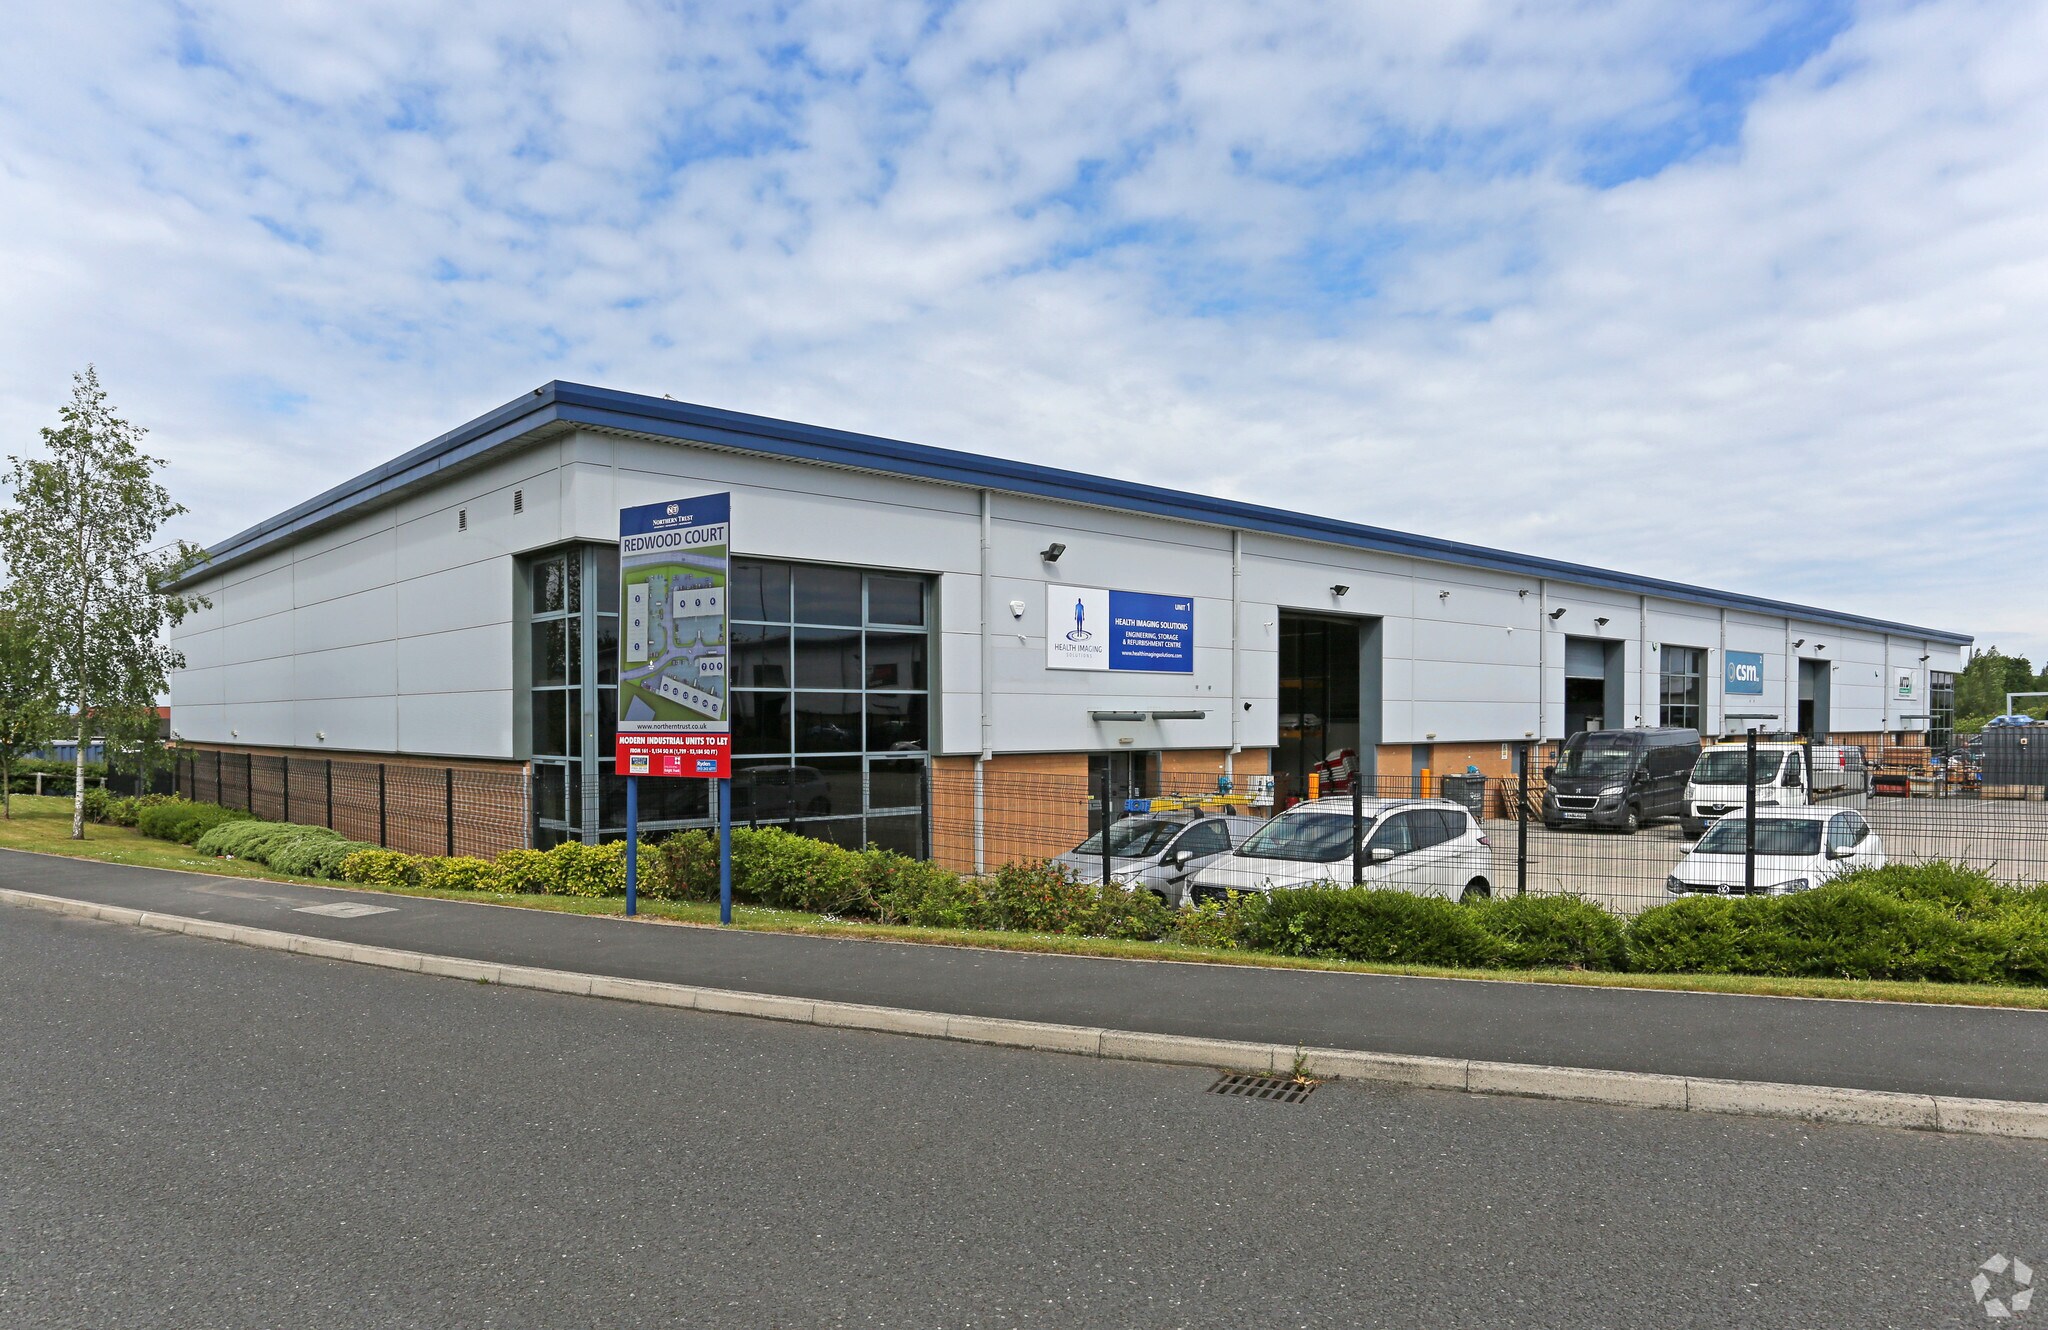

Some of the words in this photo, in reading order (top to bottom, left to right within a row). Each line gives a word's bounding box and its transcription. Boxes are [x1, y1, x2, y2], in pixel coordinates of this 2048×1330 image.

[624, 532, 682, 552] REDWOOD
[684, 526, 724, 544] COURT
[1186, 602, 1190, 611] 1
[1115, 618, 1136, 626] HEALTH
[1136, 620, 1160, 628] IMAGING
[1160, 622, 1188, 630] SOLUTIONS
[1126, 631, 1157, 640] ENGINEERING,
[1127, 639, 1164, 647] REFURBISHMENT
[1078, 644, 1102, 653] IMAGING
[1736, 664, 1756, 682] csm
